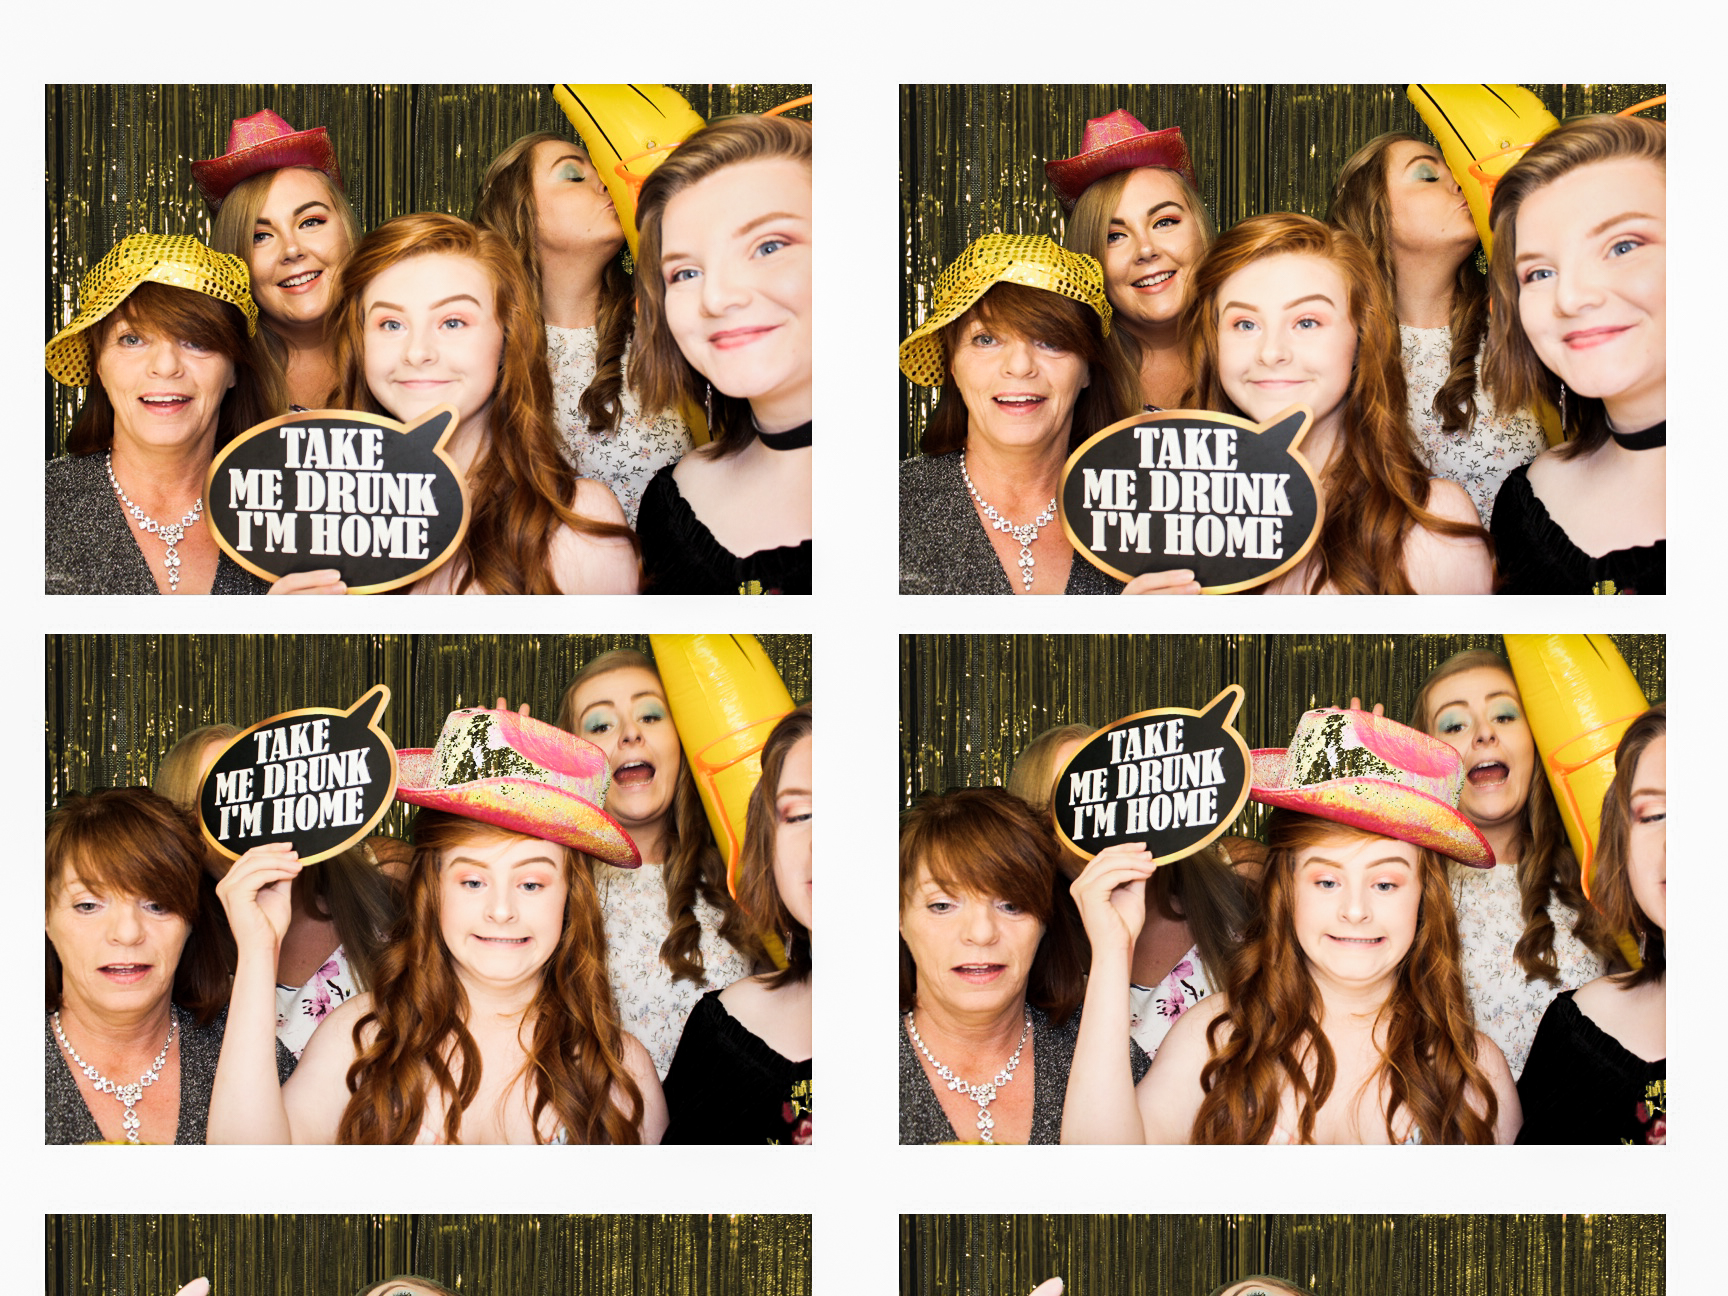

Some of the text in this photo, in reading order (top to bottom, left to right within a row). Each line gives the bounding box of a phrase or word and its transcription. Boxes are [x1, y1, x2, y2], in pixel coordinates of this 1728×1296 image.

[279, 427, 384, 471] TAKE
[1133, 427, 1238, 471] TAKE
[229, 469, 440, 517] ME DRUNK
[1083, 469, 1294, 517] ME DRUNK
[236, 511, 430, 557] I'M HOME
[1090, 511, 1284, 557] I'M HOME
[253, 718, 330, 764] TAKE
[1107, 718, 1184, 764] TAKE
[214, 747, 372, 806] ME DRUNK
[1068, 747, 1226, 806] ME DRUNK
[218, 786, 364, 841] I'M HOME
[1072, 786, 1218, 841] I'M HOME
